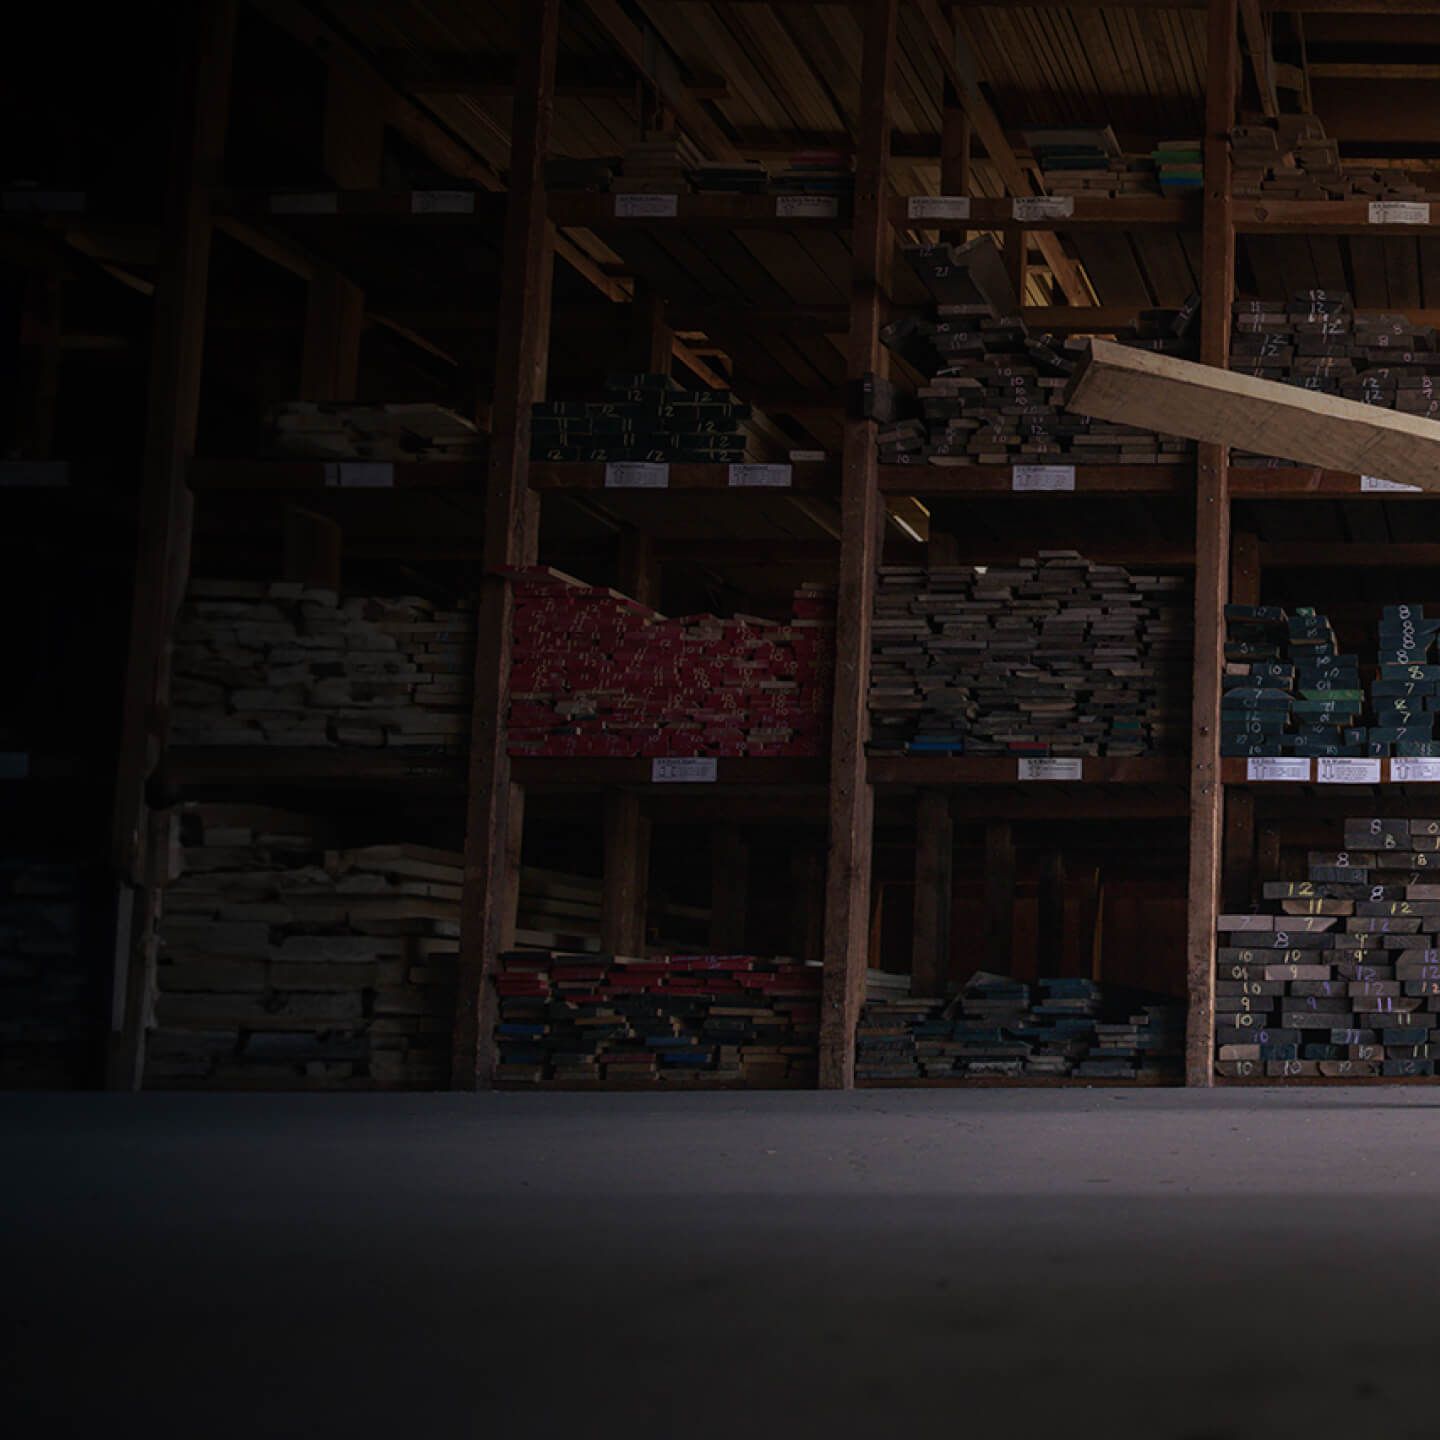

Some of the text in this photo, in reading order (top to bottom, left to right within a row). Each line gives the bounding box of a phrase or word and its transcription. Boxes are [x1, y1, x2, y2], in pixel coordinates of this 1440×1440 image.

[1404, 682, 1415, 695] 7
[1287, 880, 1315, 897] 12
[1390, 901, 1414, 915] 12
[1377, 997, 1393, 1013] 11
[1234, 1013, 1254, 1030] 10
